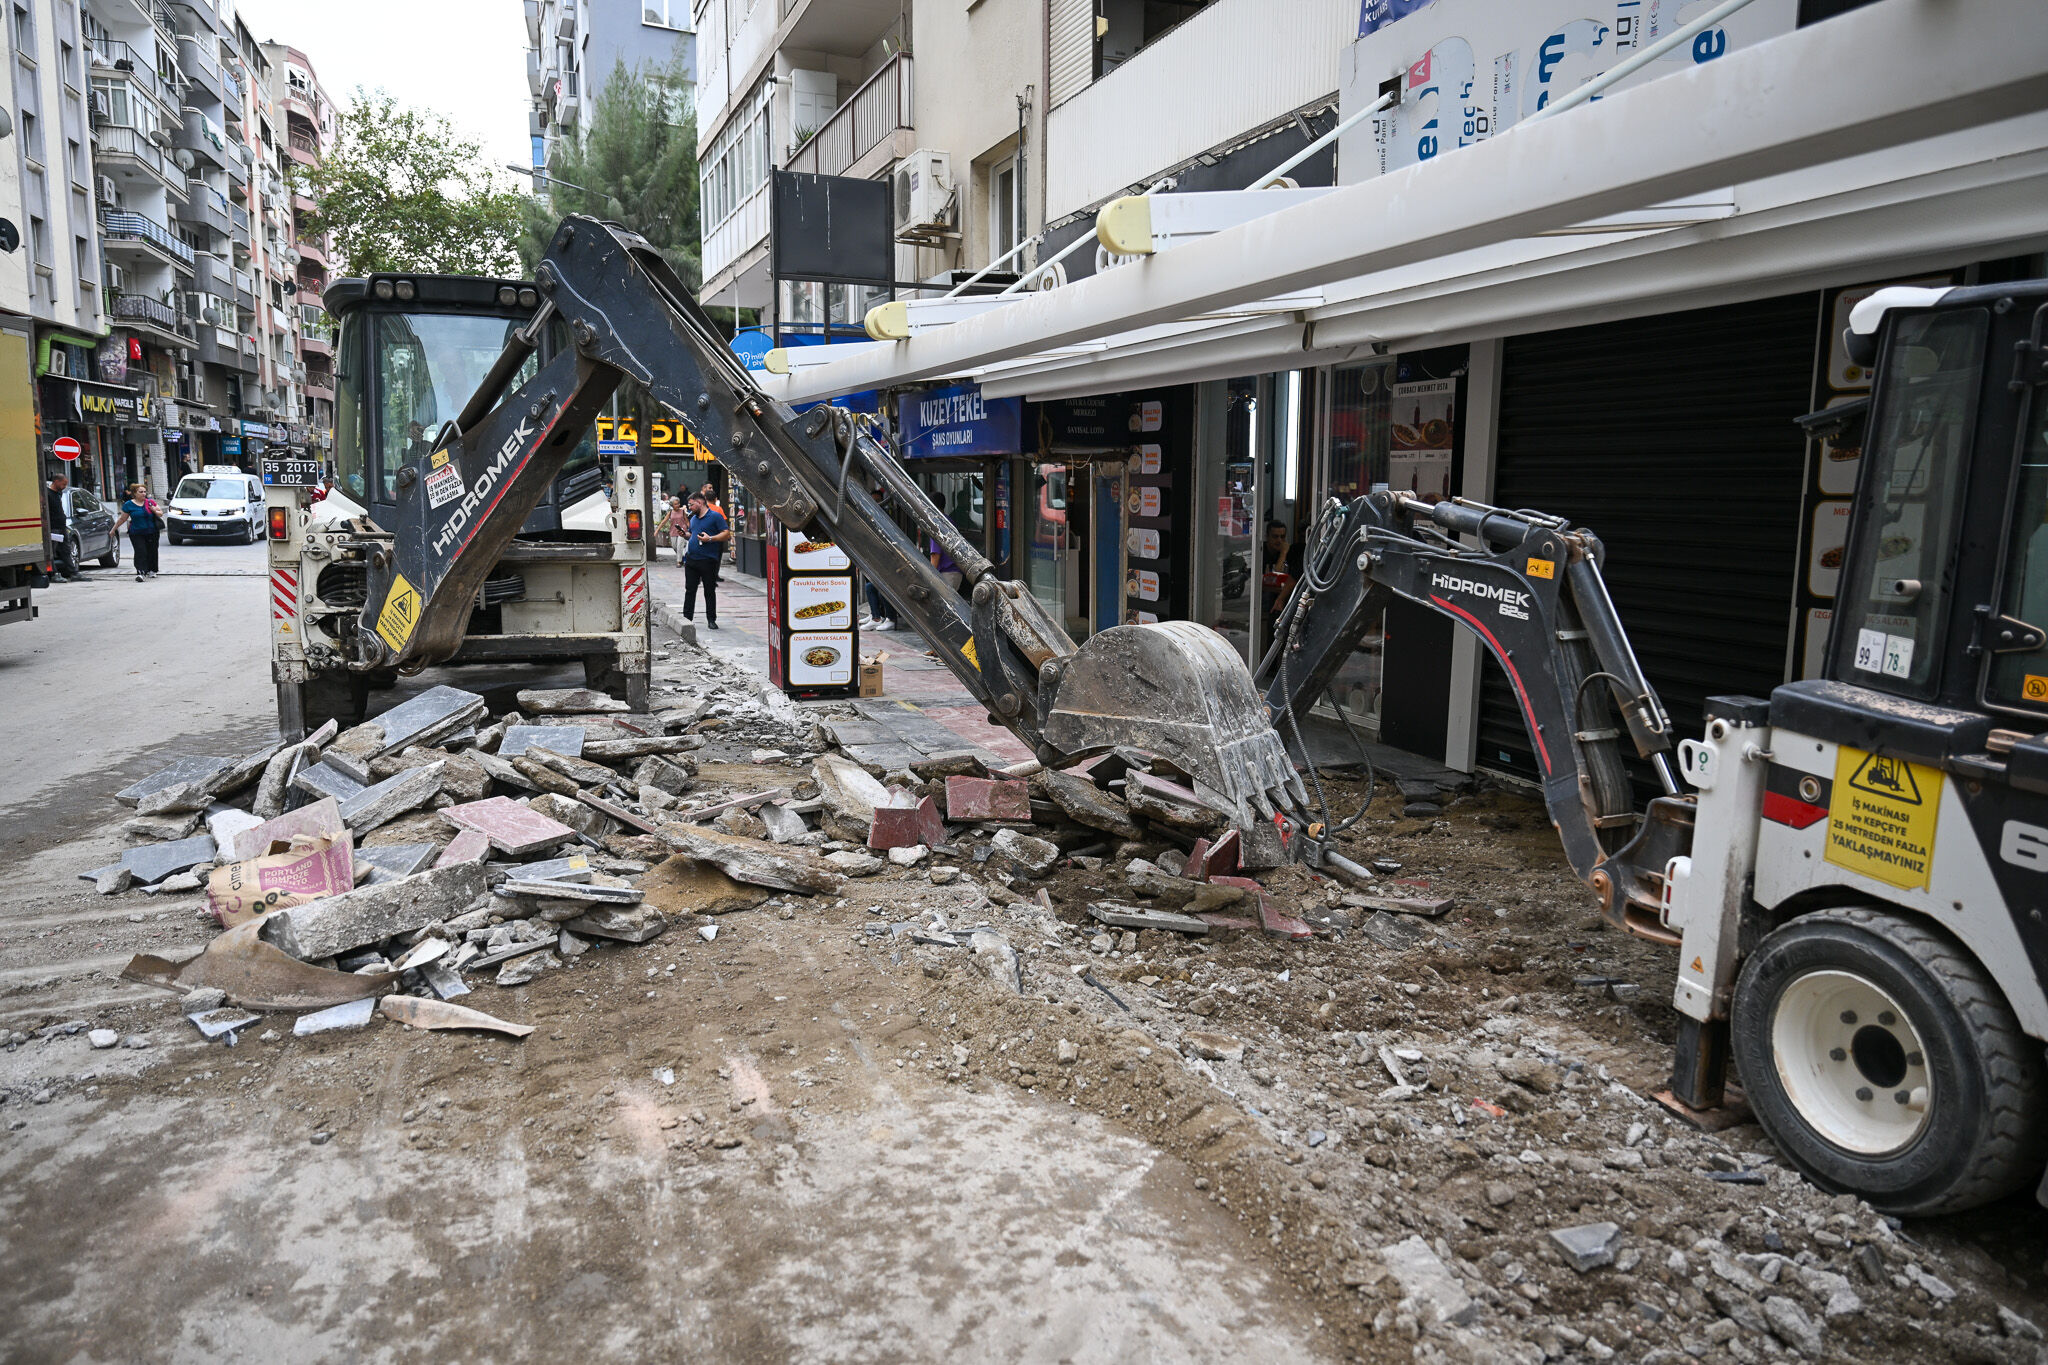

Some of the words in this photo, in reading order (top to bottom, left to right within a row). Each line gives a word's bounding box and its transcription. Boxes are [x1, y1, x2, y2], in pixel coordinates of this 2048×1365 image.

[1417, 383, 1436, 393] MEHMET
[920, 400, 952, 428] KUZEY
[953, 392, 987, 423] TEKEL
[932, 433, 946, 449] ŞANS
[946, 429, 973, 446] OYUNLARI
[264, 462, 280, 473] 35
[286, 462, 316, 473] 2012
[280, 474, 303, 484] 002
[1858, 646, 1871, 666] 99
[1886, 652, 1900, 672] 78
[1852, 796, 1860, 810] İŞ
[1862, 801, 1910, 824] MAKİNASI
[1851, 814, 1862, 823] ve
[1863, 815, 1907, 837] KEPÇEYE
[1833, 819, 1843, 830] 25
[1844, 823, 1894, 847] METREDEN
[1895, 839, 1927, 857] FAZLA
[1831, 833, 1925, 873] YAKLAŞMAYINIZ
